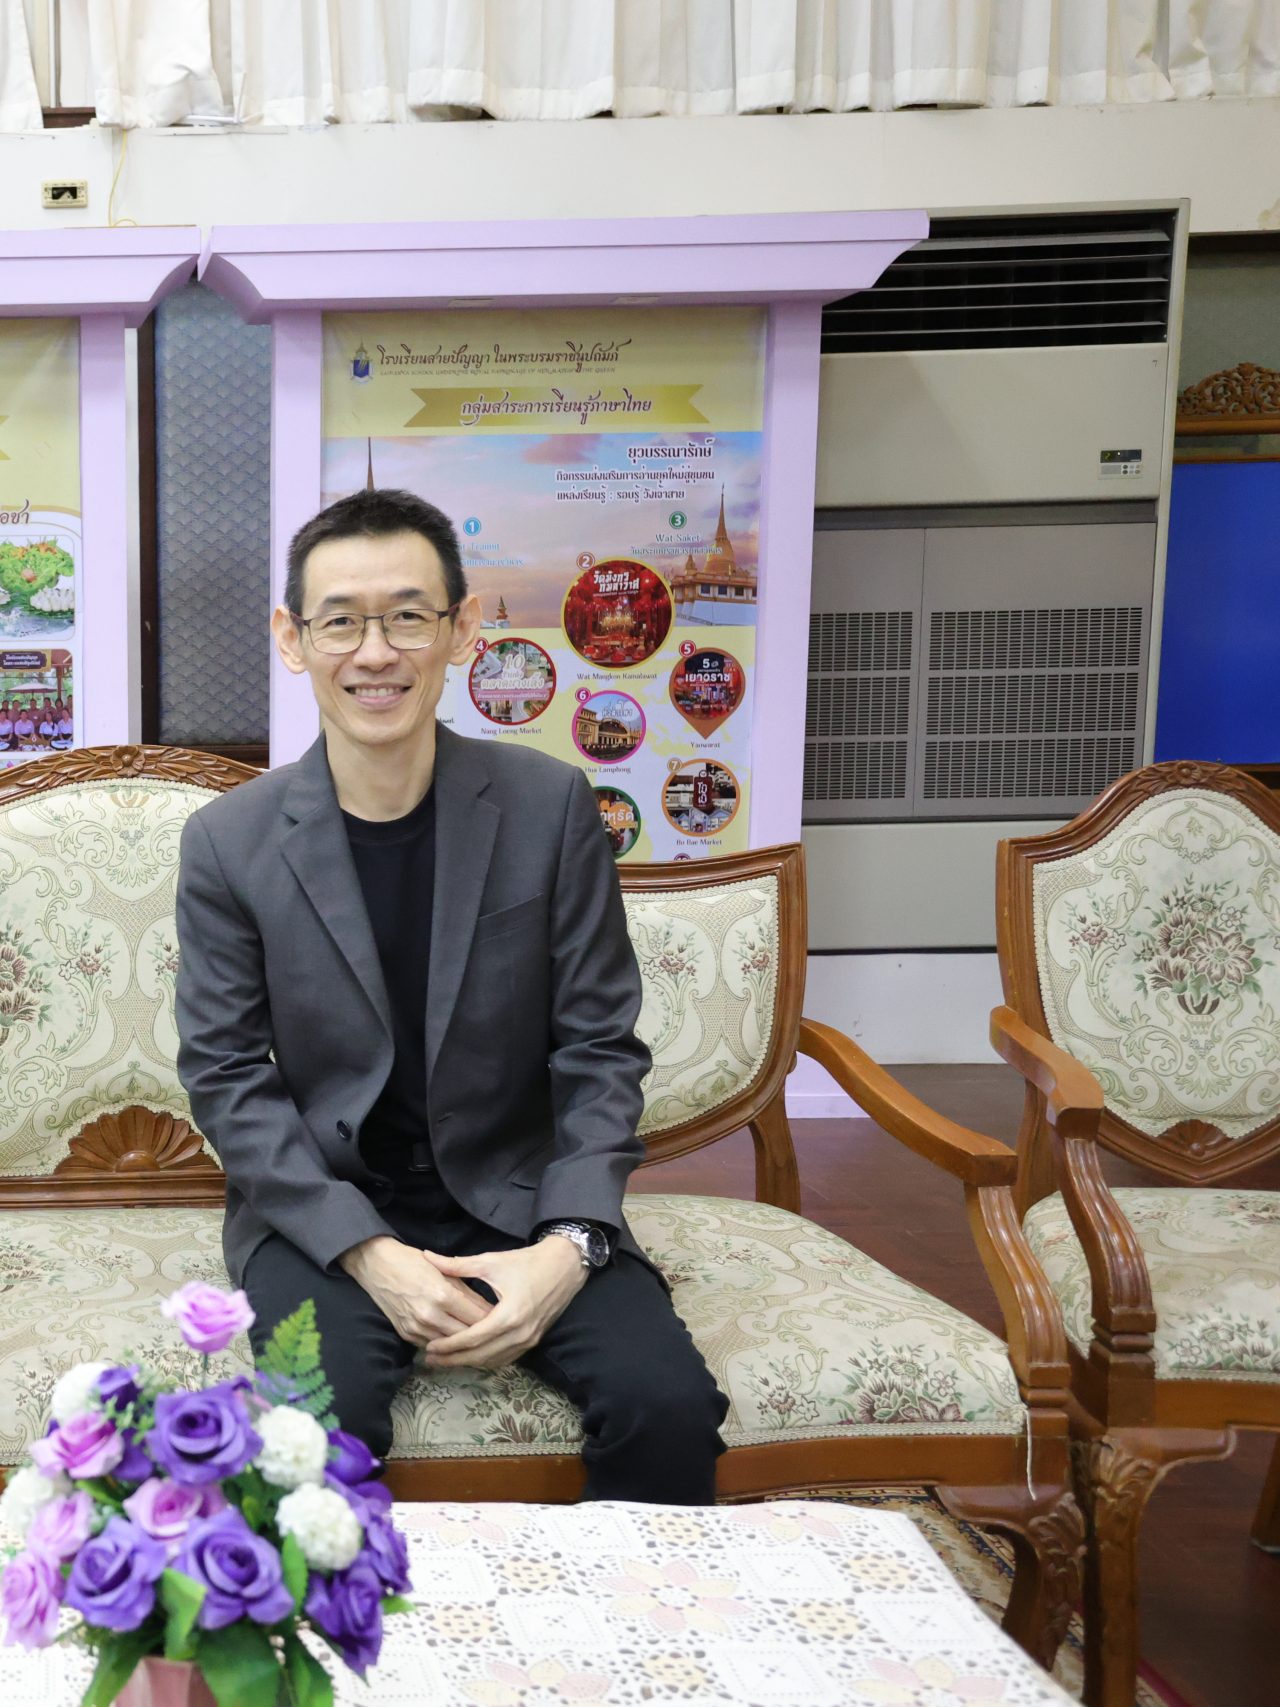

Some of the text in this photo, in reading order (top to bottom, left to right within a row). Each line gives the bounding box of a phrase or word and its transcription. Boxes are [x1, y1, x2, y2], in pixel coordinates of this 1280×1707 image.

[377, 343, 490, 370] โรงเรียนสายปัญญา
[460, 387, 652, 426] กลุ่มสาระการเรียนรู้ภาษาไทย
[628, 439, 714, 463] ยุวบรรณารักษ์
[674, 514, 682, 526] 3
[582, 555, 590, 568] 2
[476, 640, 484, 651] 4
[683, 643, 691, 654] 5
[702, 658, 710, 669] 5
[685, 673, 730, 682] เยาวราช
[579, 690, 587, 701] 6
[671, 760, 678, 770] 7
[600, 808, 635, 825] าหุรัด
